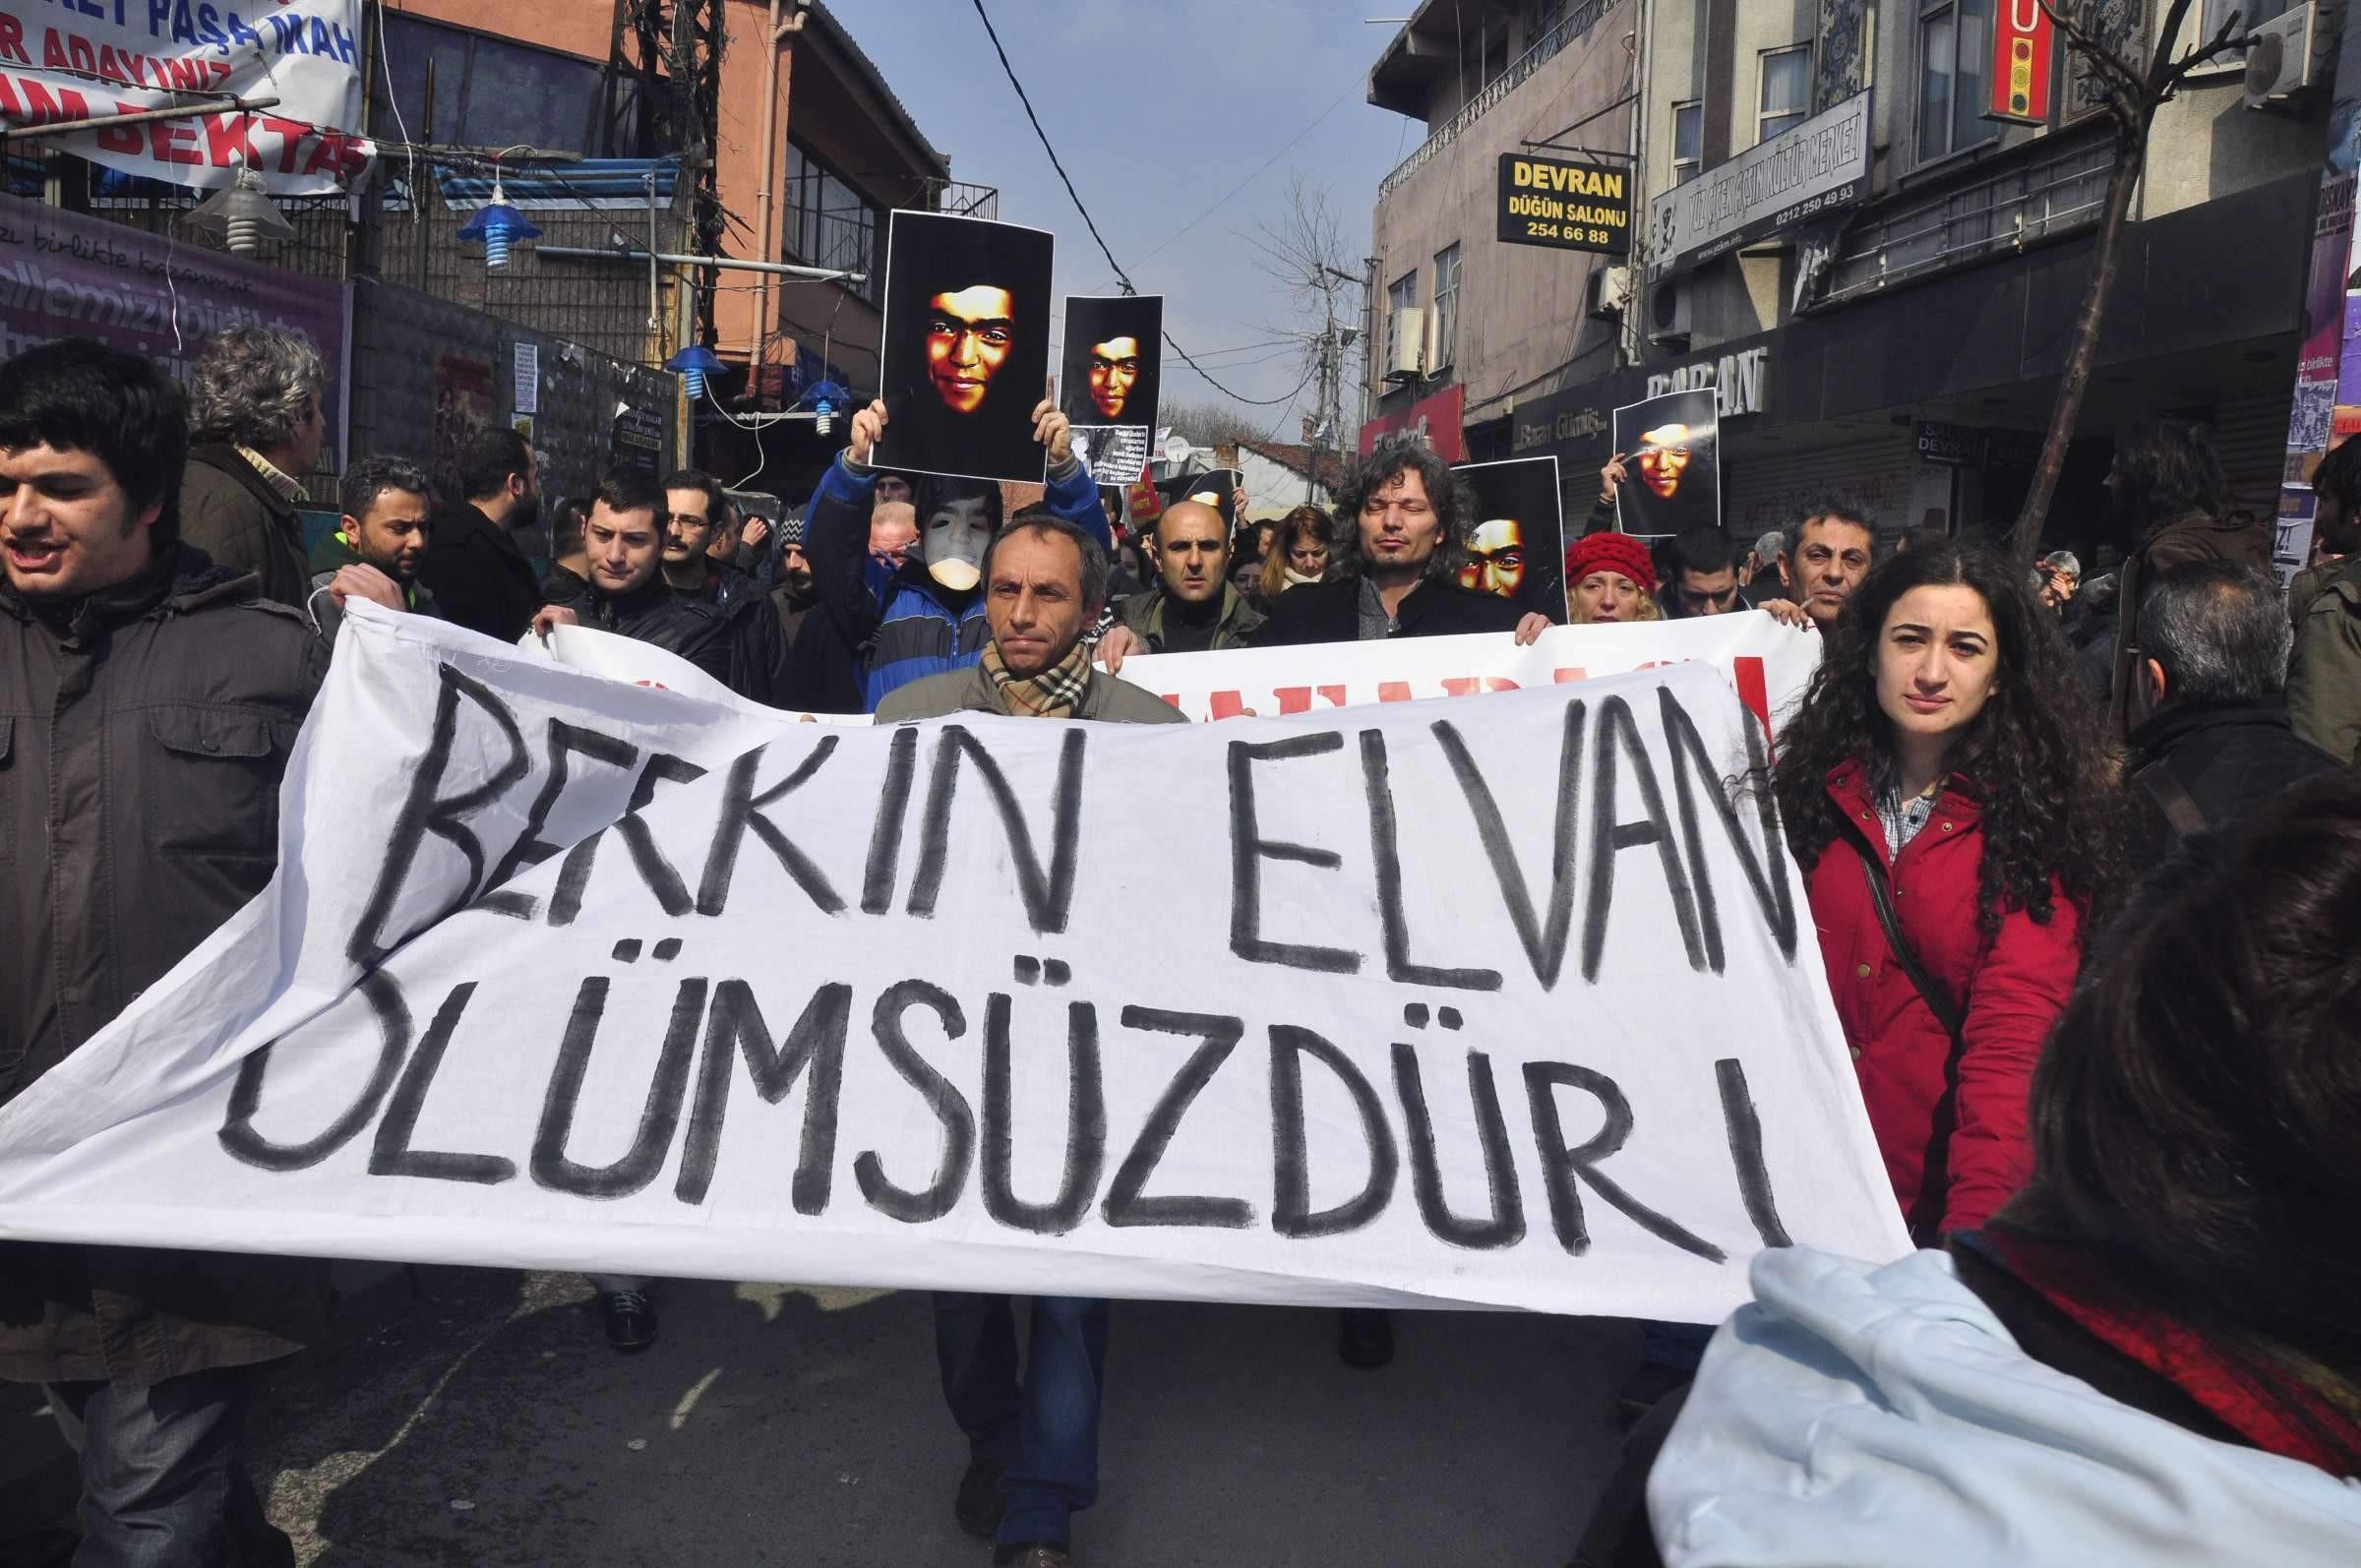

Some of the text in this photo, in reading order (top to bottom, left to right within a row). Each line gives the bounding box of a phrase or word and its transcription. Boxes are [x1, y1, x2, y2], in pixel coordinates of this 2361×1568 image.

[266, 14, 360, 68] MAH
[1808, 100, 1862, 180] MERKEZİ
[1515, 161, 1622, 199] DEVRAN
[1509, 195, 1626, 227] DÜĞÜN SALONU
[1776, 184, 1854, 226] 0212 250 49 93
[32, 224, 130, 269] birlikte
[1527, 221, 1609, 244] 254 66 88
[1228, 685, 1798, 992] ELVAN
